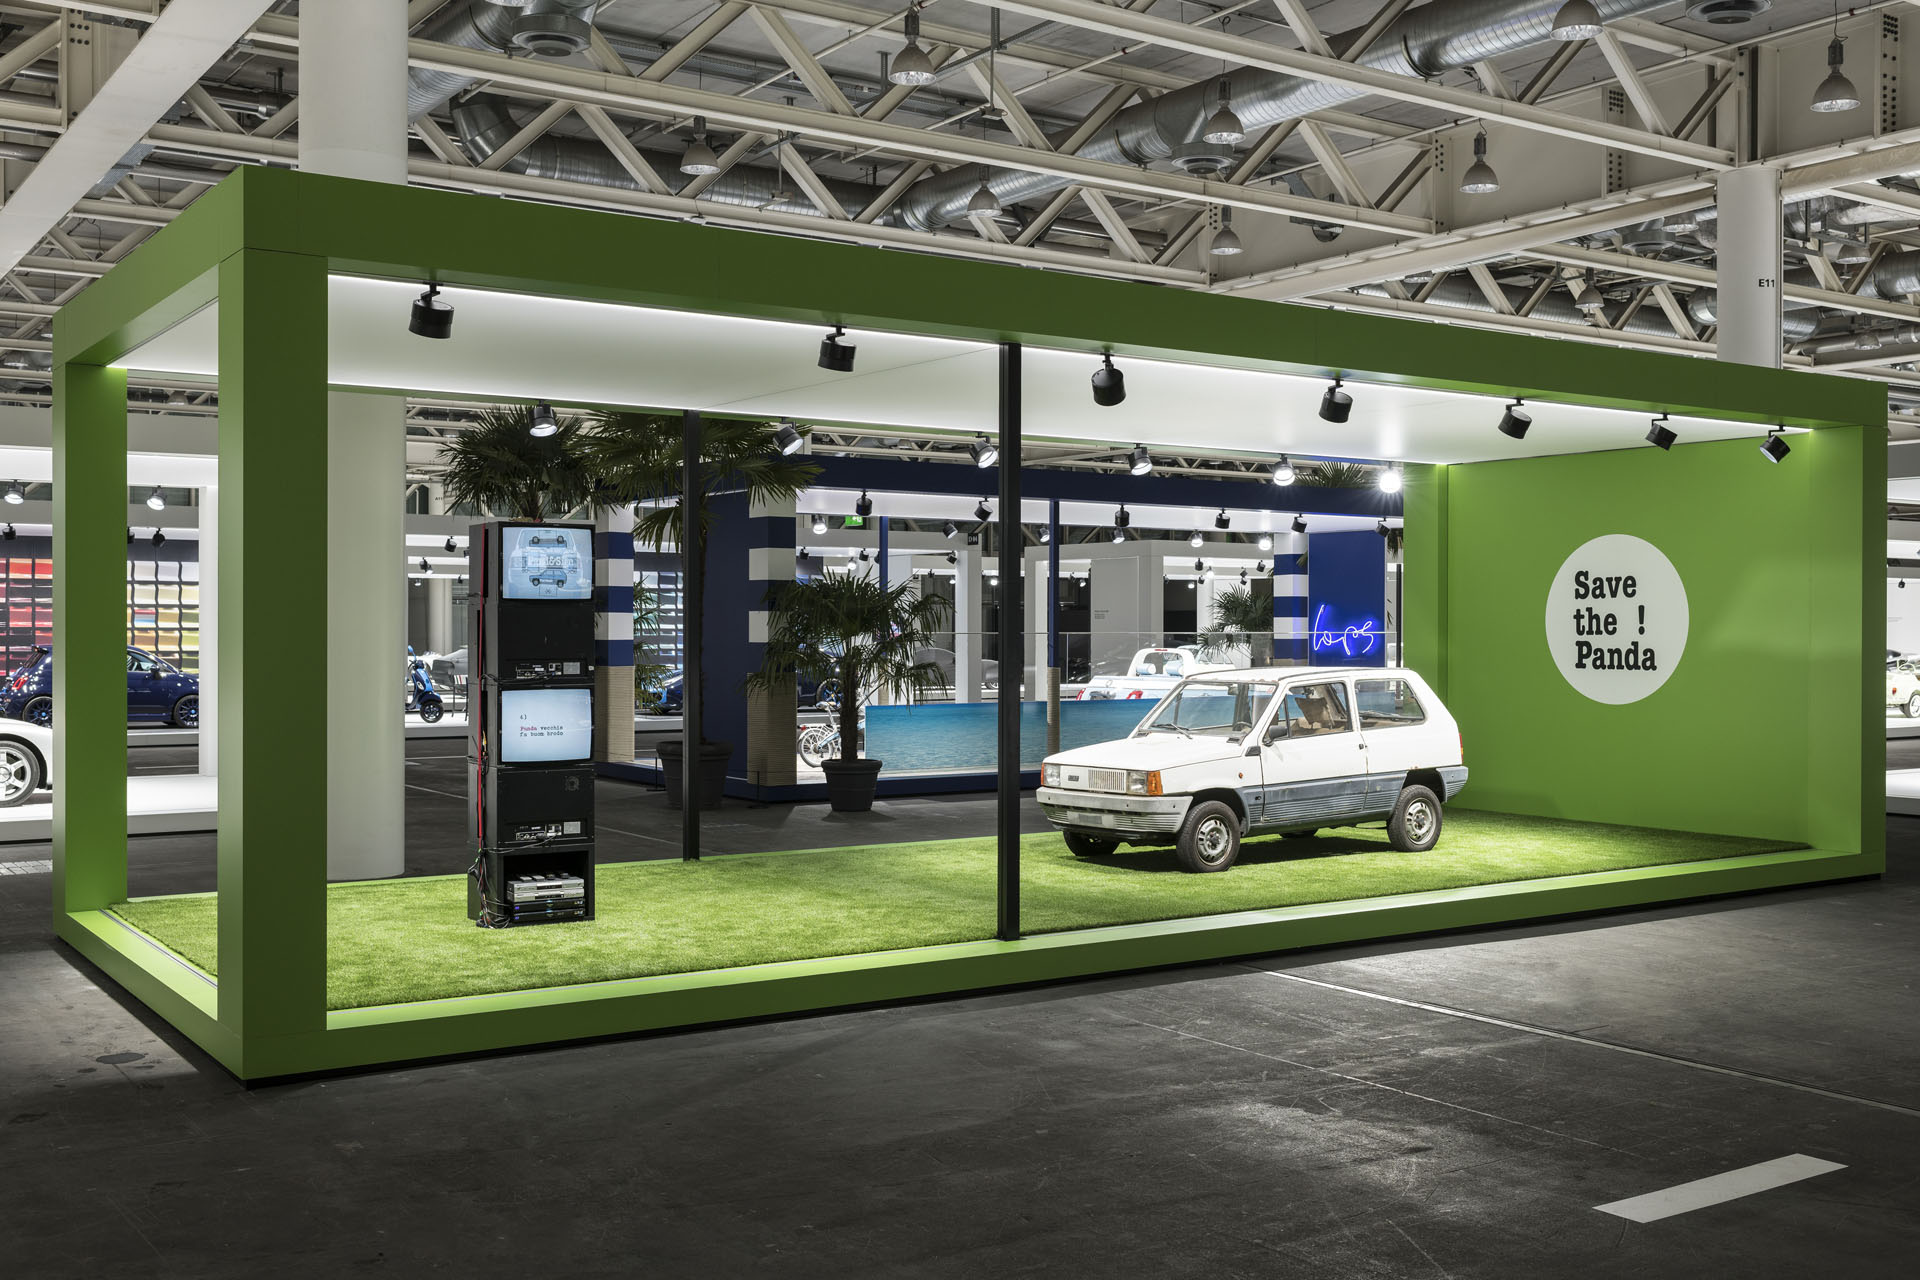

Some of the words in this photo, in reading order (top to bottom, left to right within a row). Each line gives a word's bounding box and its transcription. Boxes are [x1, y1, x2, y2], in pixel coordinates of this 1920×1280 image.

[1758, 278, 1775, 288] E11
[1574, 570, 1637, 600] Save
[1573, 606, 1618, 636] the
[1637, 604, 1645, 636] !
[1574, 640, 1658, 671] Panda
